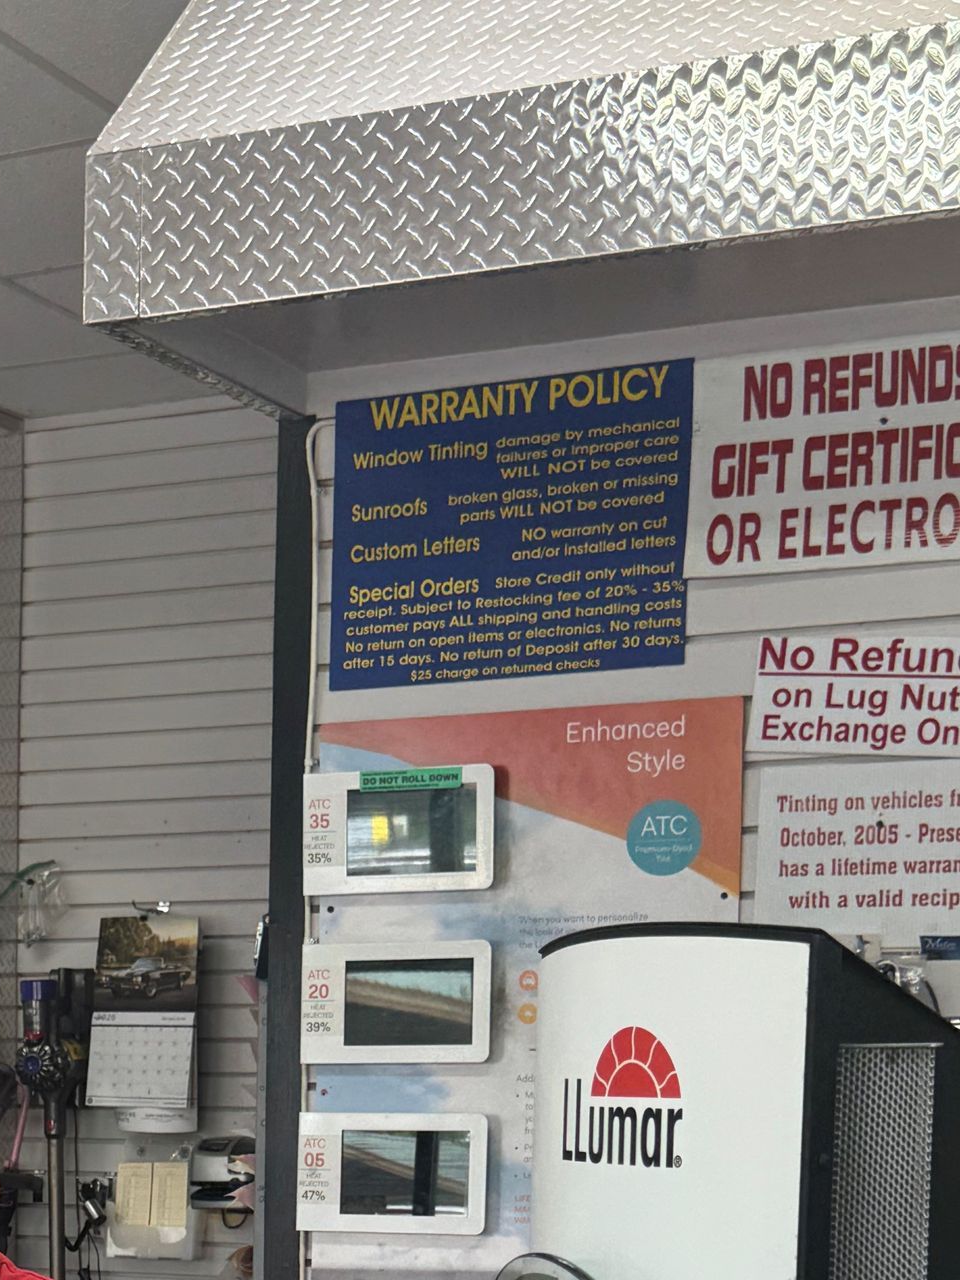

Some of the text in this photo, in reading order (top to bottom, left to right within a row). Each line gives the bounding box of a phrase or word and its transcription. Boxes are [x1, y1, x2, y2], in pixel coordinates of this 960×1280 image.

[743, 344, 960, 422] NO REFUND
[370, 365, 670, 431] WARRANTY POLICY
[496, 416, 680, 449] damage by mechanical
[353, 441, 488, 470] Window Tinting
[711, 439, 794, 499] GIFT
[352, 497, 427, 522] Sunroofs
[522, 516, 668, 542] NO warranty on cut
[706, 492, 960, 566] OR ELECTRO
[351, 536, 481, 563] Custom Letters
[512, 535, 677, 561] and/or installed letters
[495, 561, 676, 589] Store Credit only without
[350, 578, 480, 607] Special Orders
[758, 637, 960, 673] No Refun
[772, 688, 812, 708] on
[825, 682, 888, 717] Lug
[566, 715, 686, 744] Enhanced
[761, 714, 907, 751] Exchange
[626, 751, 686, 777] Style
[363, 773, 459, 786] DO NOT ROLL DOWN
[309, 799, 331, 810] ATC
[776, 794, 838, 816] Tinting
[844, 796, 865, 810] on
[871, 790, 943, 810] vehicles
[310, 814, 330, 829] 35
[641, 815, 688, 837] ATC
[780, 827, 846, 847] October,
[854, 824, 899, 845] 2005
[308, 853, 332, 864] 35%
[778, 860, 809, 877] has
[831, 858, 898, 876] lifetime
[788, 889, 960, 910] with valid recip
[308, 969, 330, 980] ATC
[309, 984, 329, 999] 20
[306, 1022, 331, 1033] 39%
[562, 1078, 682, 1168] LLumar
[304, 1138, 327, 1149] ATC
[304, 1152, 325, 1168] 05
[302, 1190, 326, 1201] 47%
